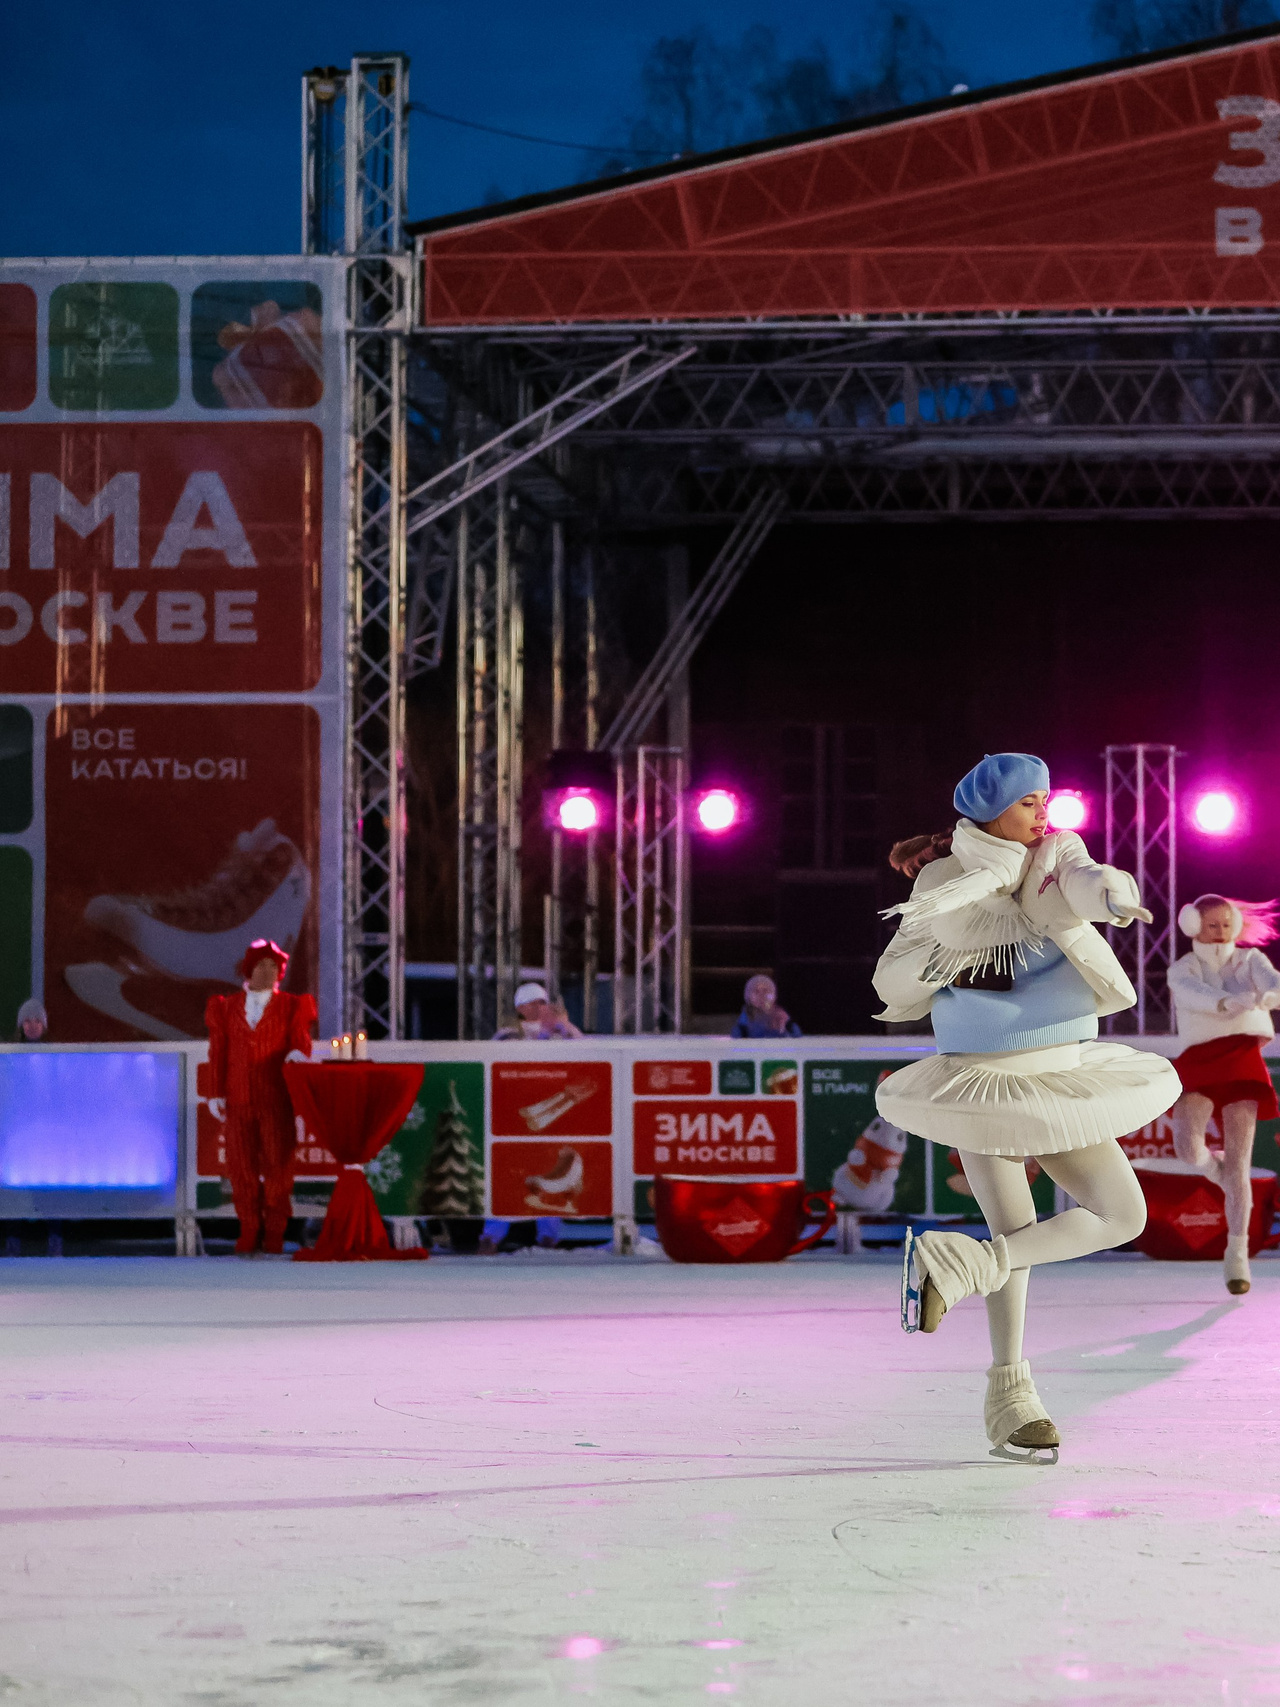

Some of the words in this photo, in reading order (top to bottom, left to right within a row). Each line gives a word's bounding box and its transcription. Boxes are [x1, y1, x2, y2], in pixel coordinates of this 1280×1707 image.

[1215, 206, 1264, 256] В
[0, 471, 258, 569] МА
[72, 728, 136, 750] ВСЕ
[72, 758, 247, 780] КАТАТЬСЯ!
[654, 1113, 775, 1142] ЗИМА
[655, 1146, 670, 1162] В
[677, 1146, 776, 1162] МОСКВЕ
